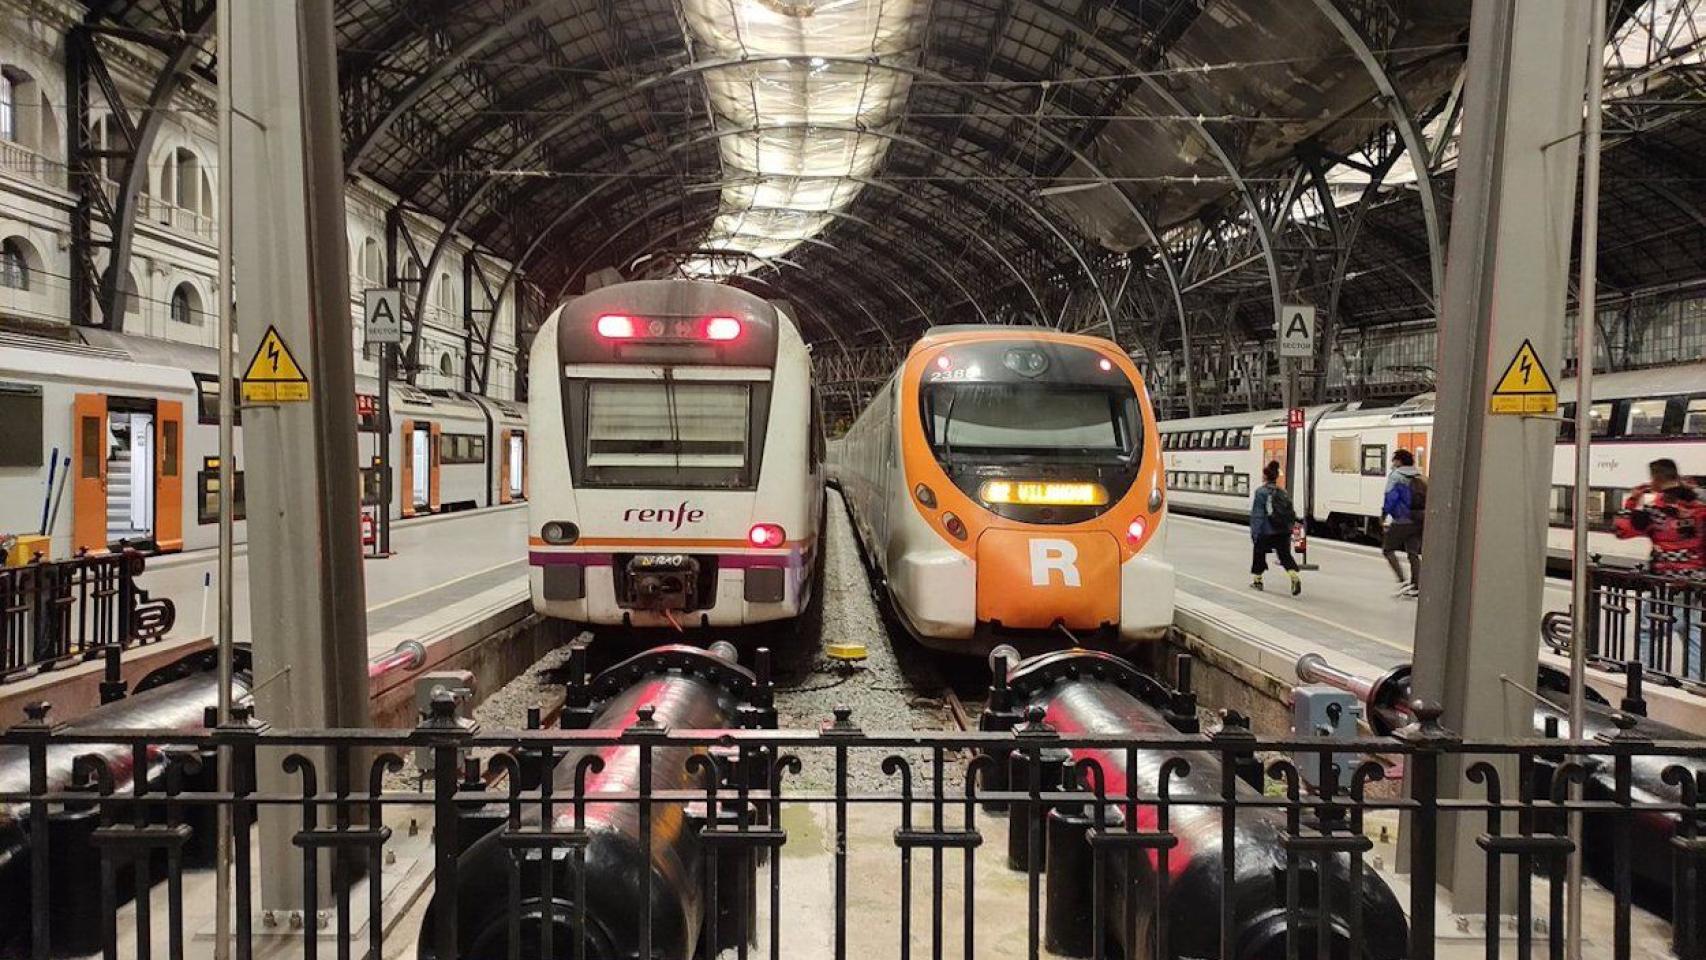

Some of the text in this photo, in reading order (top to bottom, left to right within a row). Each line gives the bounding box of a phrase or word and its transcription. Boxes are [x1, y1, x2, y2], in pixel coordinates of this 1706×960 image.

[371, 297, 395, 324] A
[1286, 312, 1308, 339] A
[624, 501, 704, 532] renfe
[1028, 538, 1081, 587] R
